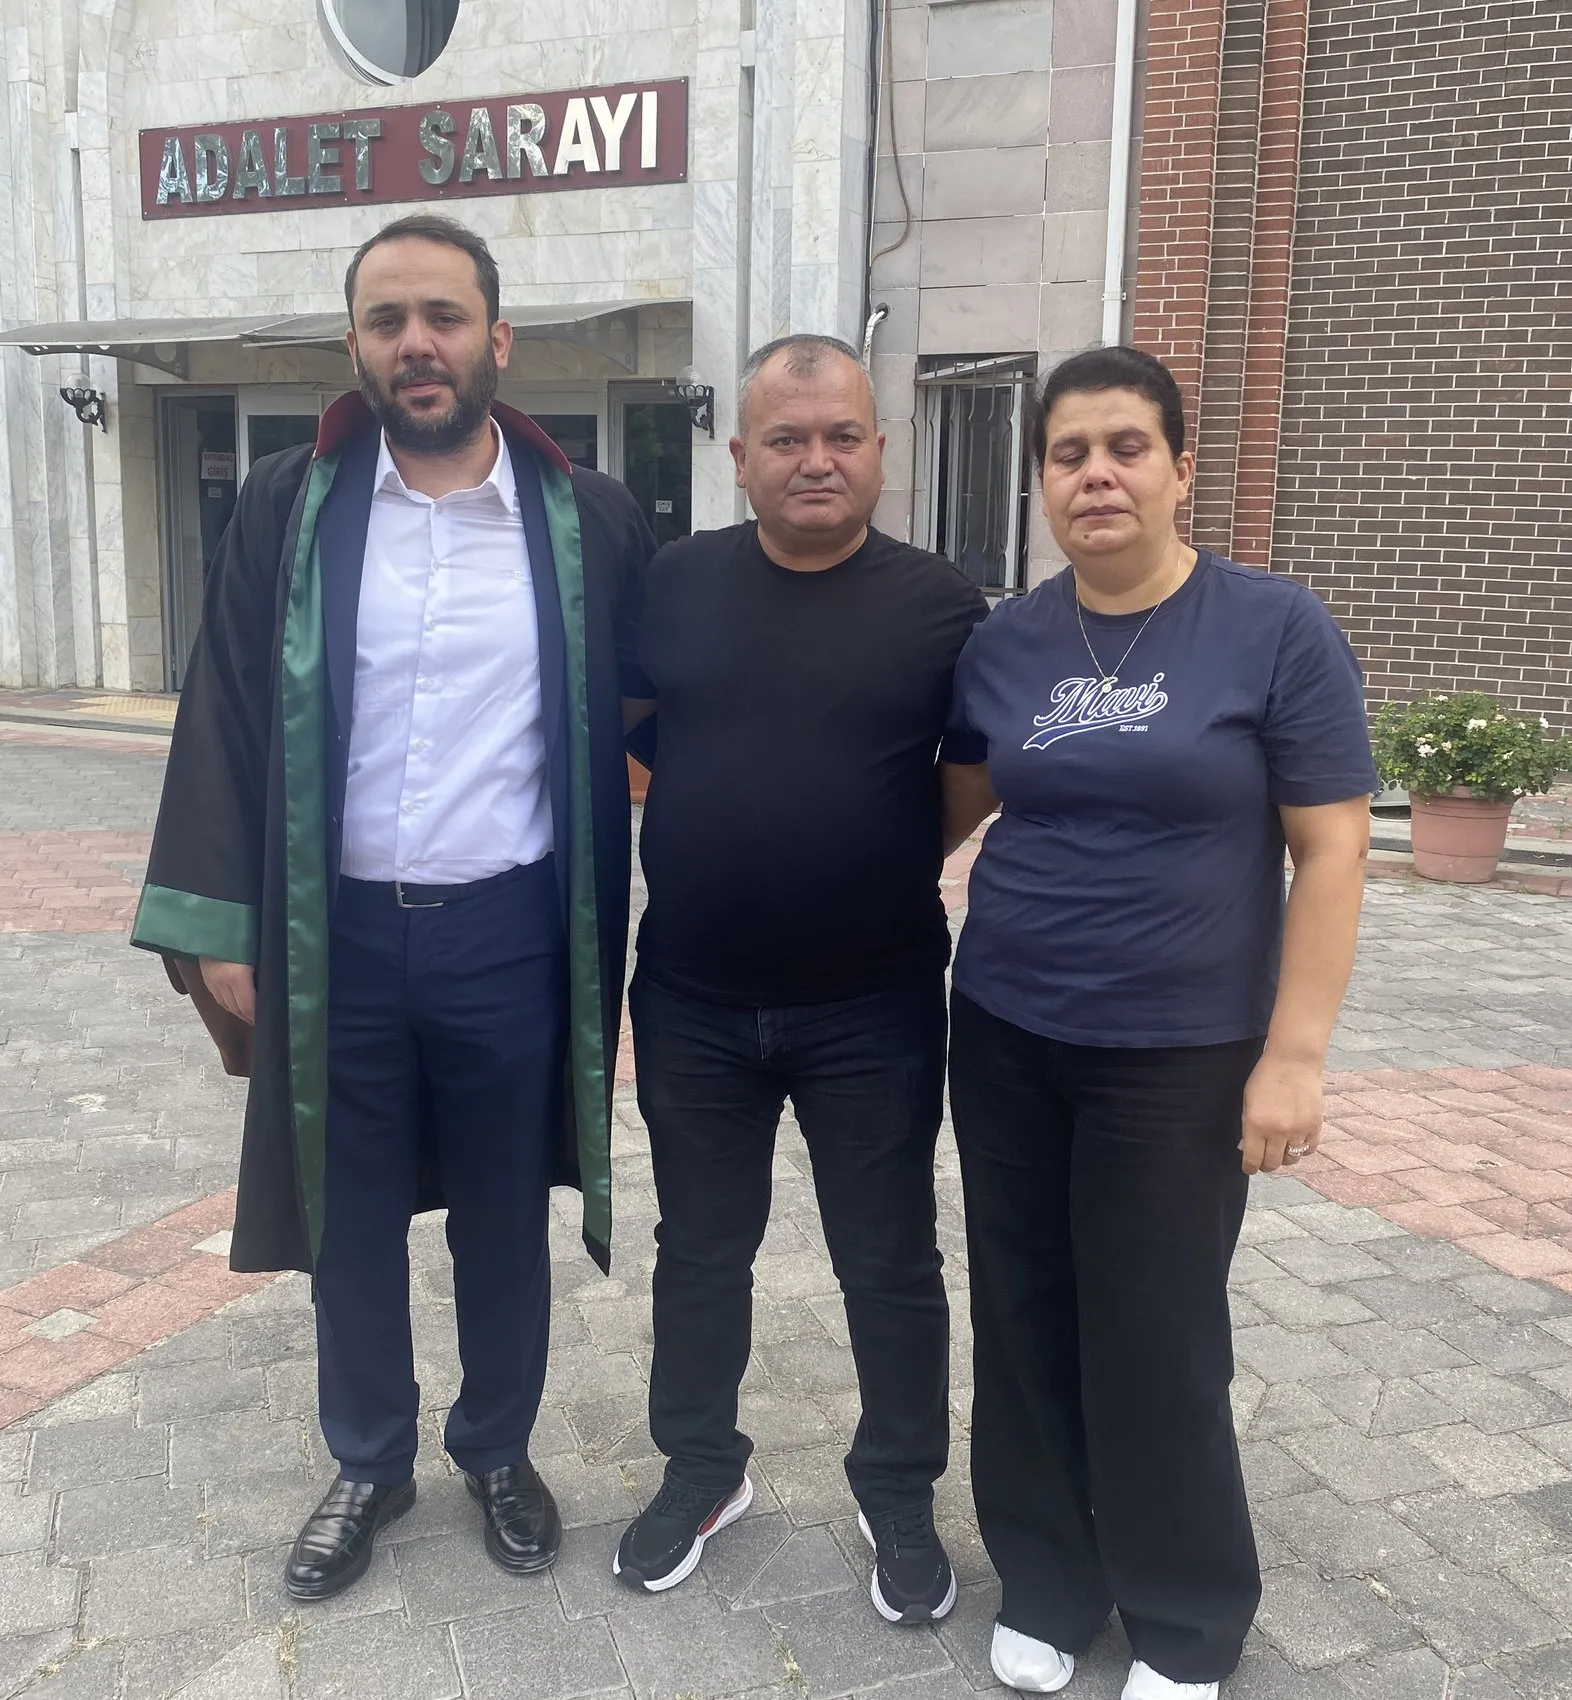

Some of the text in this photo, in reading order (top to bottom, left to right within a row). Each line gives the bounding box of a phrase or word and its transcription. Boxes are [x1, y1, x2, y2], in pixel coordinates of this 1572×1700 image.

[156, 91, 658, 205] ADALET SARAYI
[1033, 672, 1169, 727] Mavi
